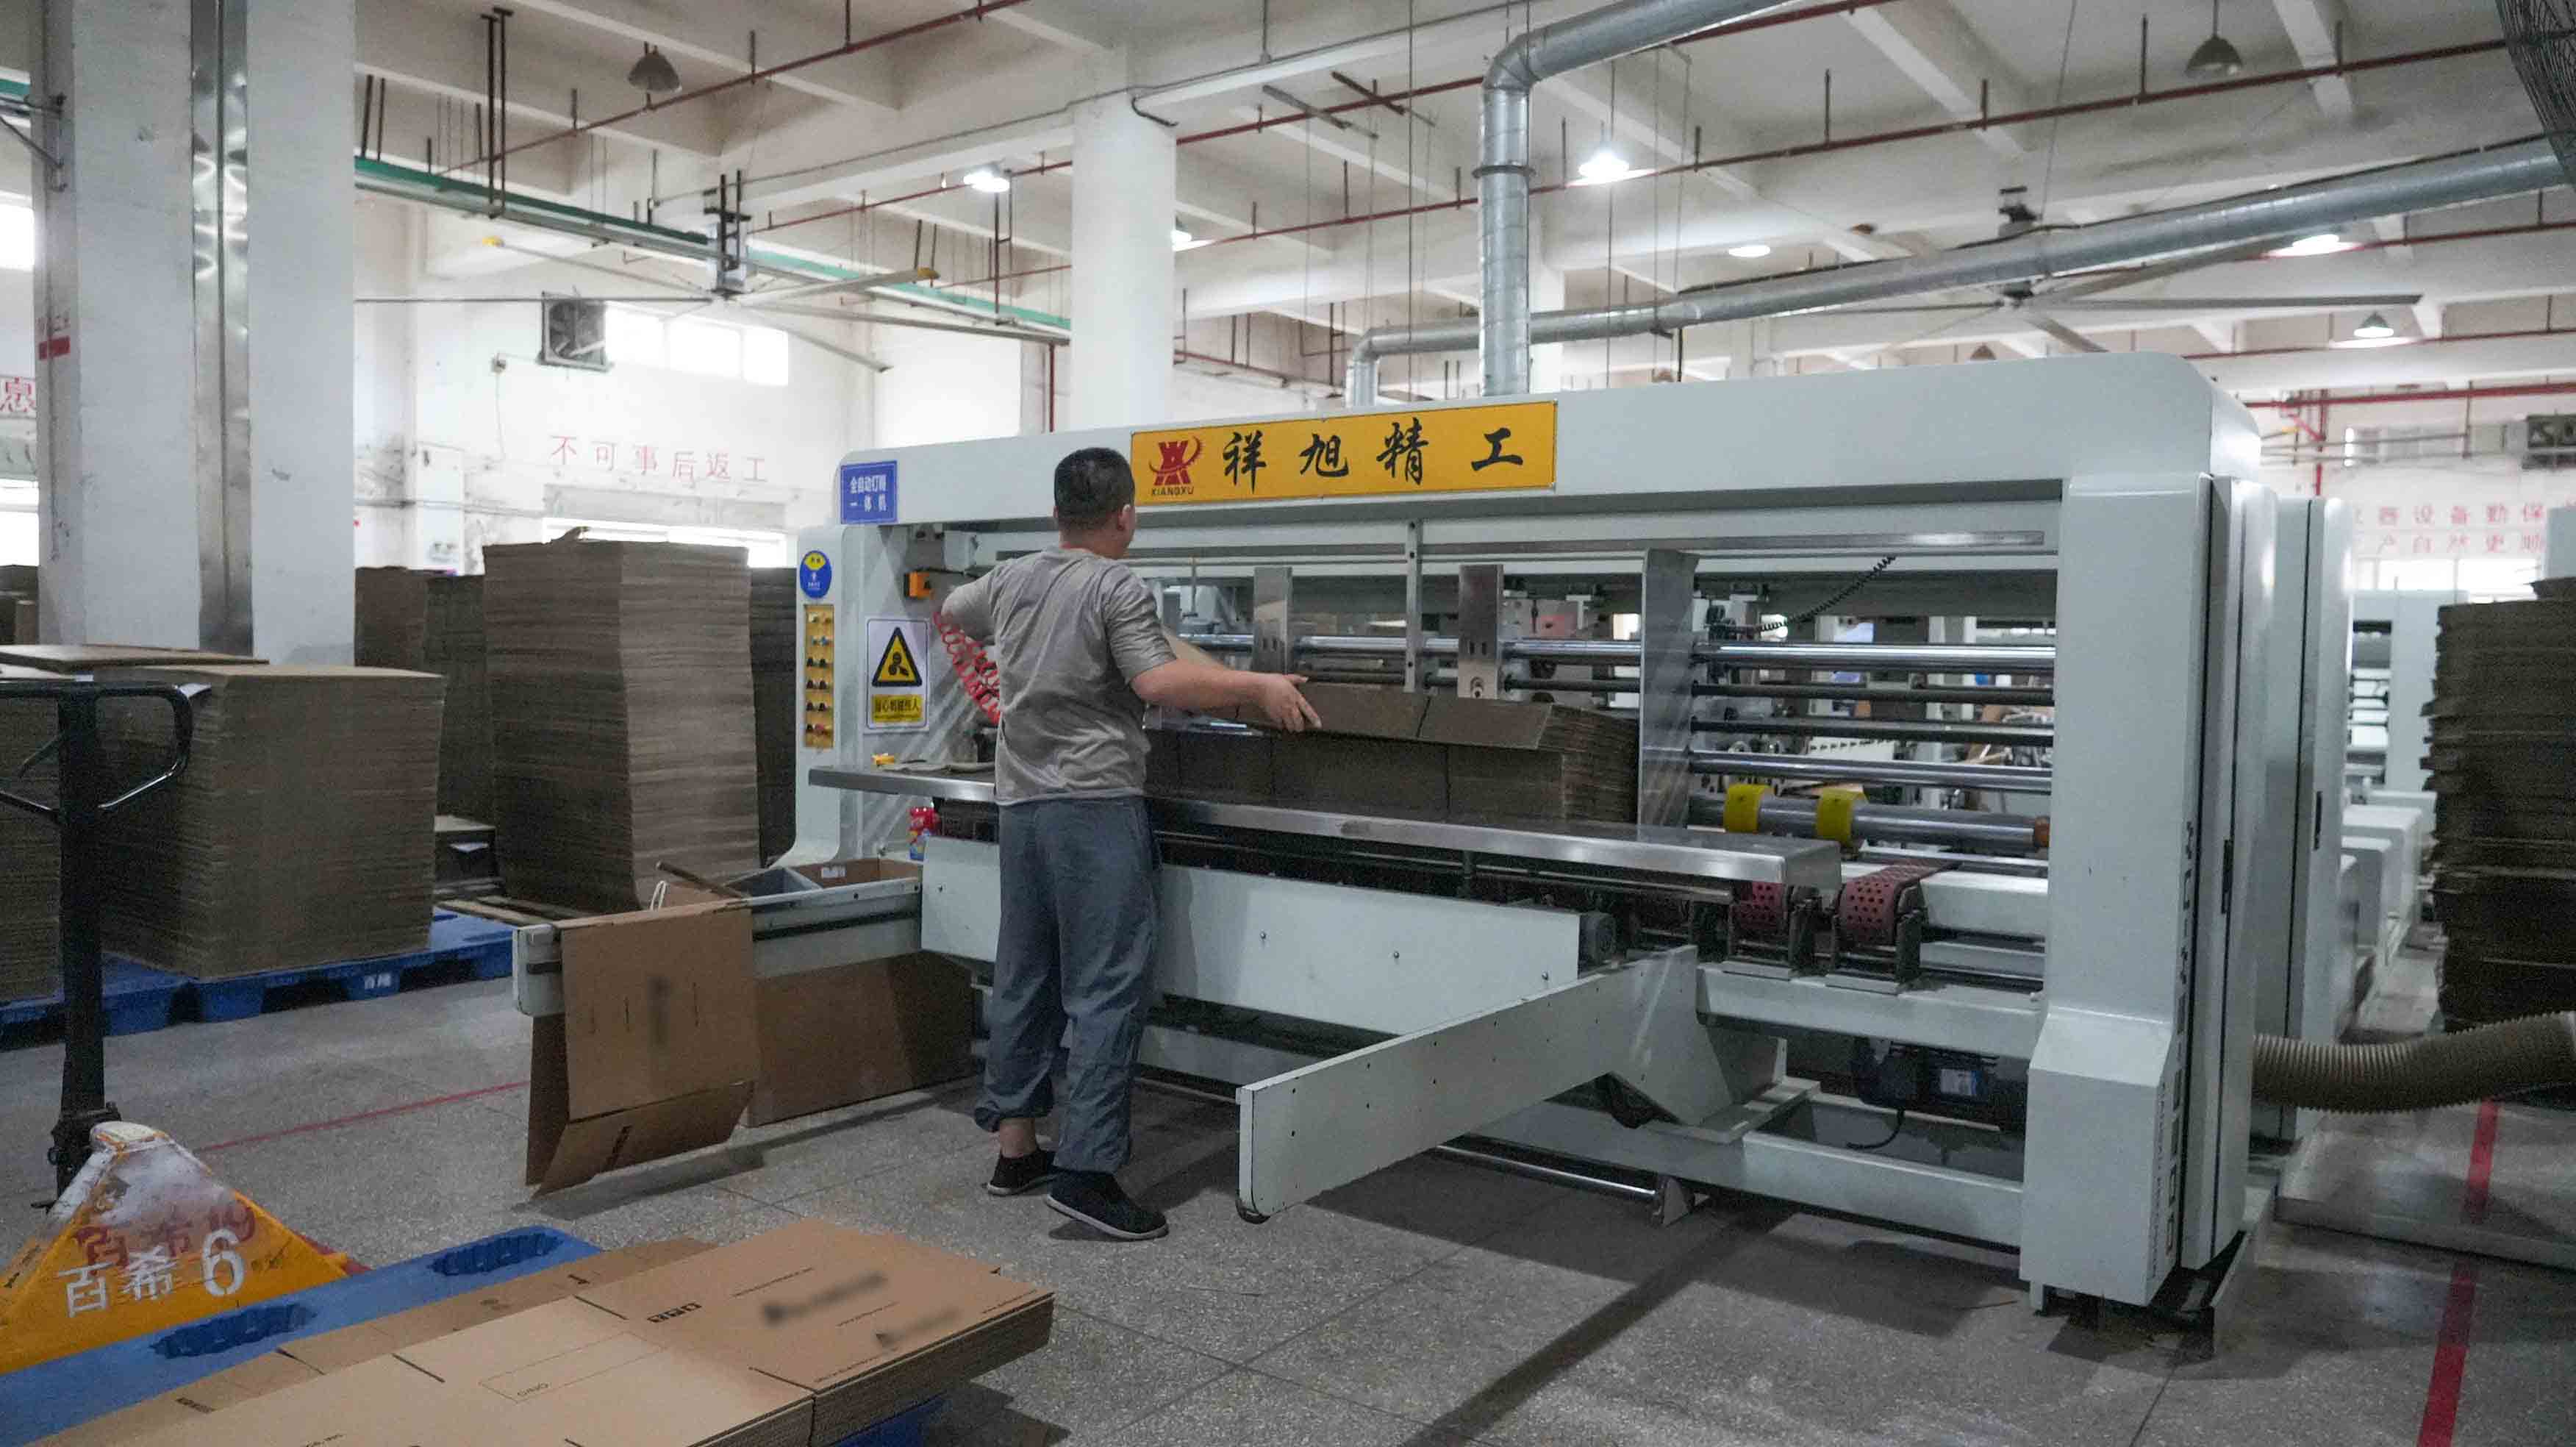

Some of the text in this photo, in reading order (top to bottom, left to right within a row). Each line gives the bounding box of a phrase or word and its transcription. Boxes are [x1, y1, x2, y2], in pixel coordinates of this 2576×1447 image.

[550, 435, 768, 483] 不可事后返工
[1222, 418, 1524, 494] 祥旭精工
[2355, 500, 2576, 526] 器设备勤保
[57, 1246, 177, 1318] 百希
[201, 1229, 245, 1296] 6
